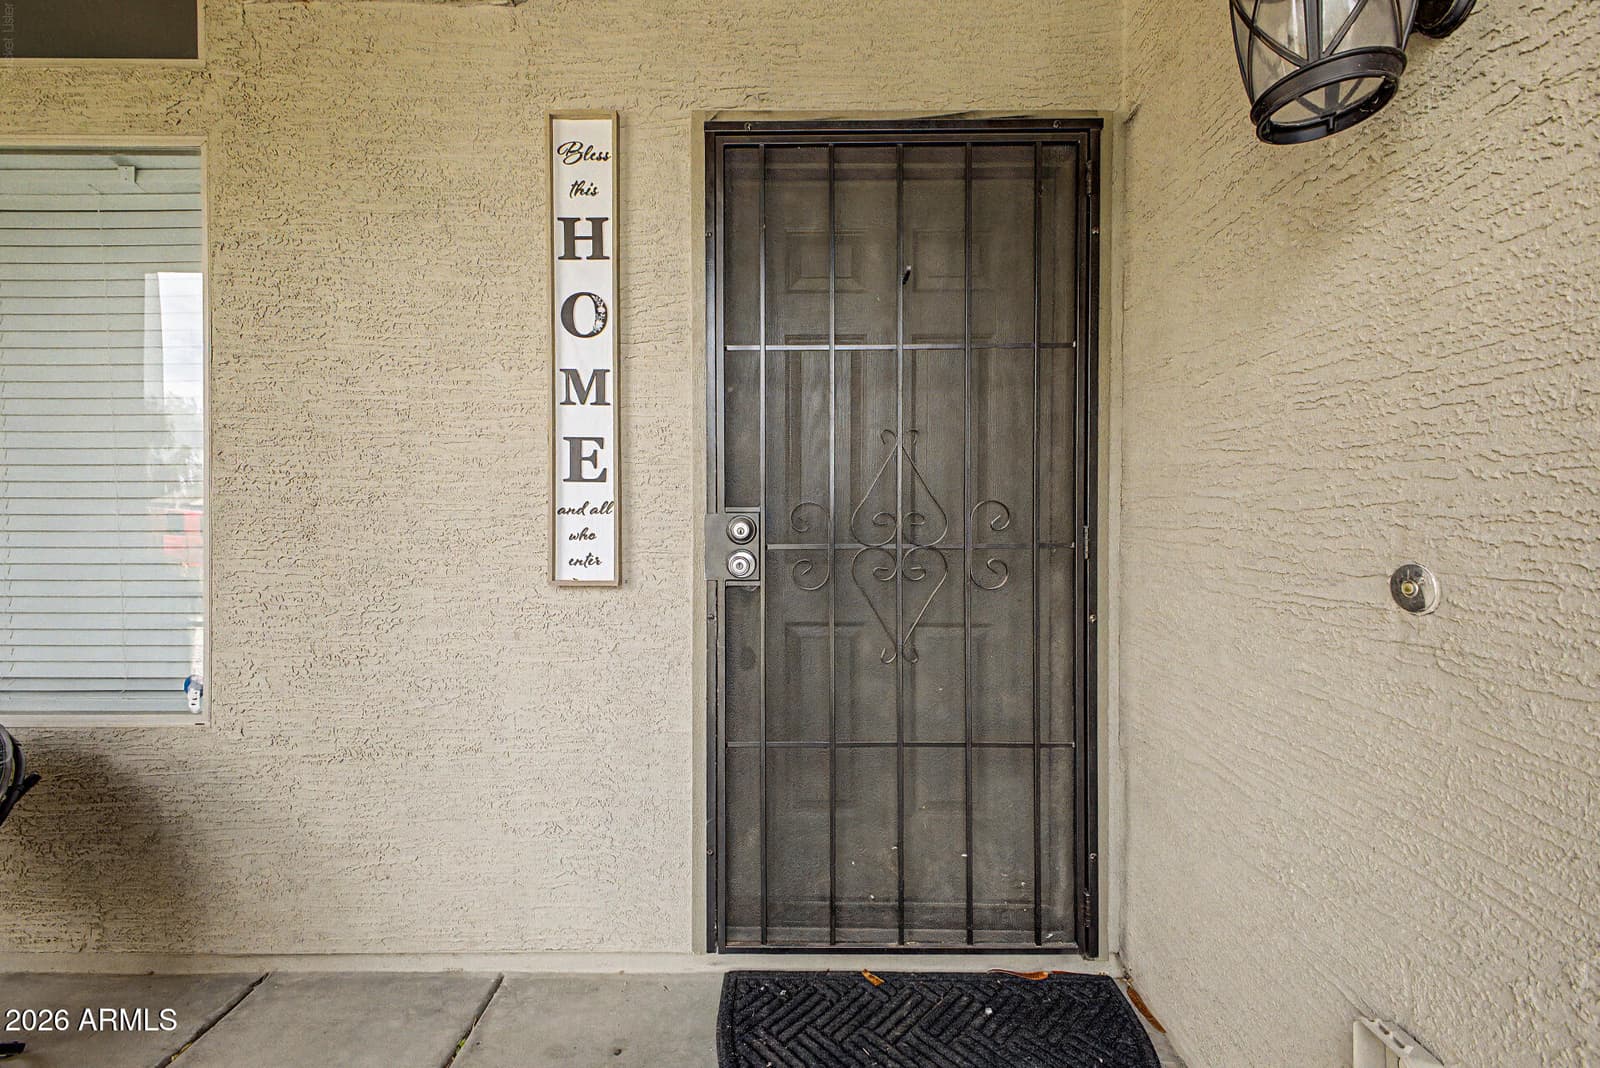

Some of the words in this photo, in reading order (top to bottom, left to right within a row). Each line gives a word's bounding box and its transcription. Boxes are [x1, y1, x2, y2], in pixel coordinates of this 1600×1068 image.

[557, 141, 611, 165] Bless
[569, 180, 599, 198] this
[557, 216, 611, 483] HOME
[557, 501, 589, 515] and
[589, 501, 614, 515] all
[568, 527, 597, 541] who
[568, 552, 602, 566] enter
